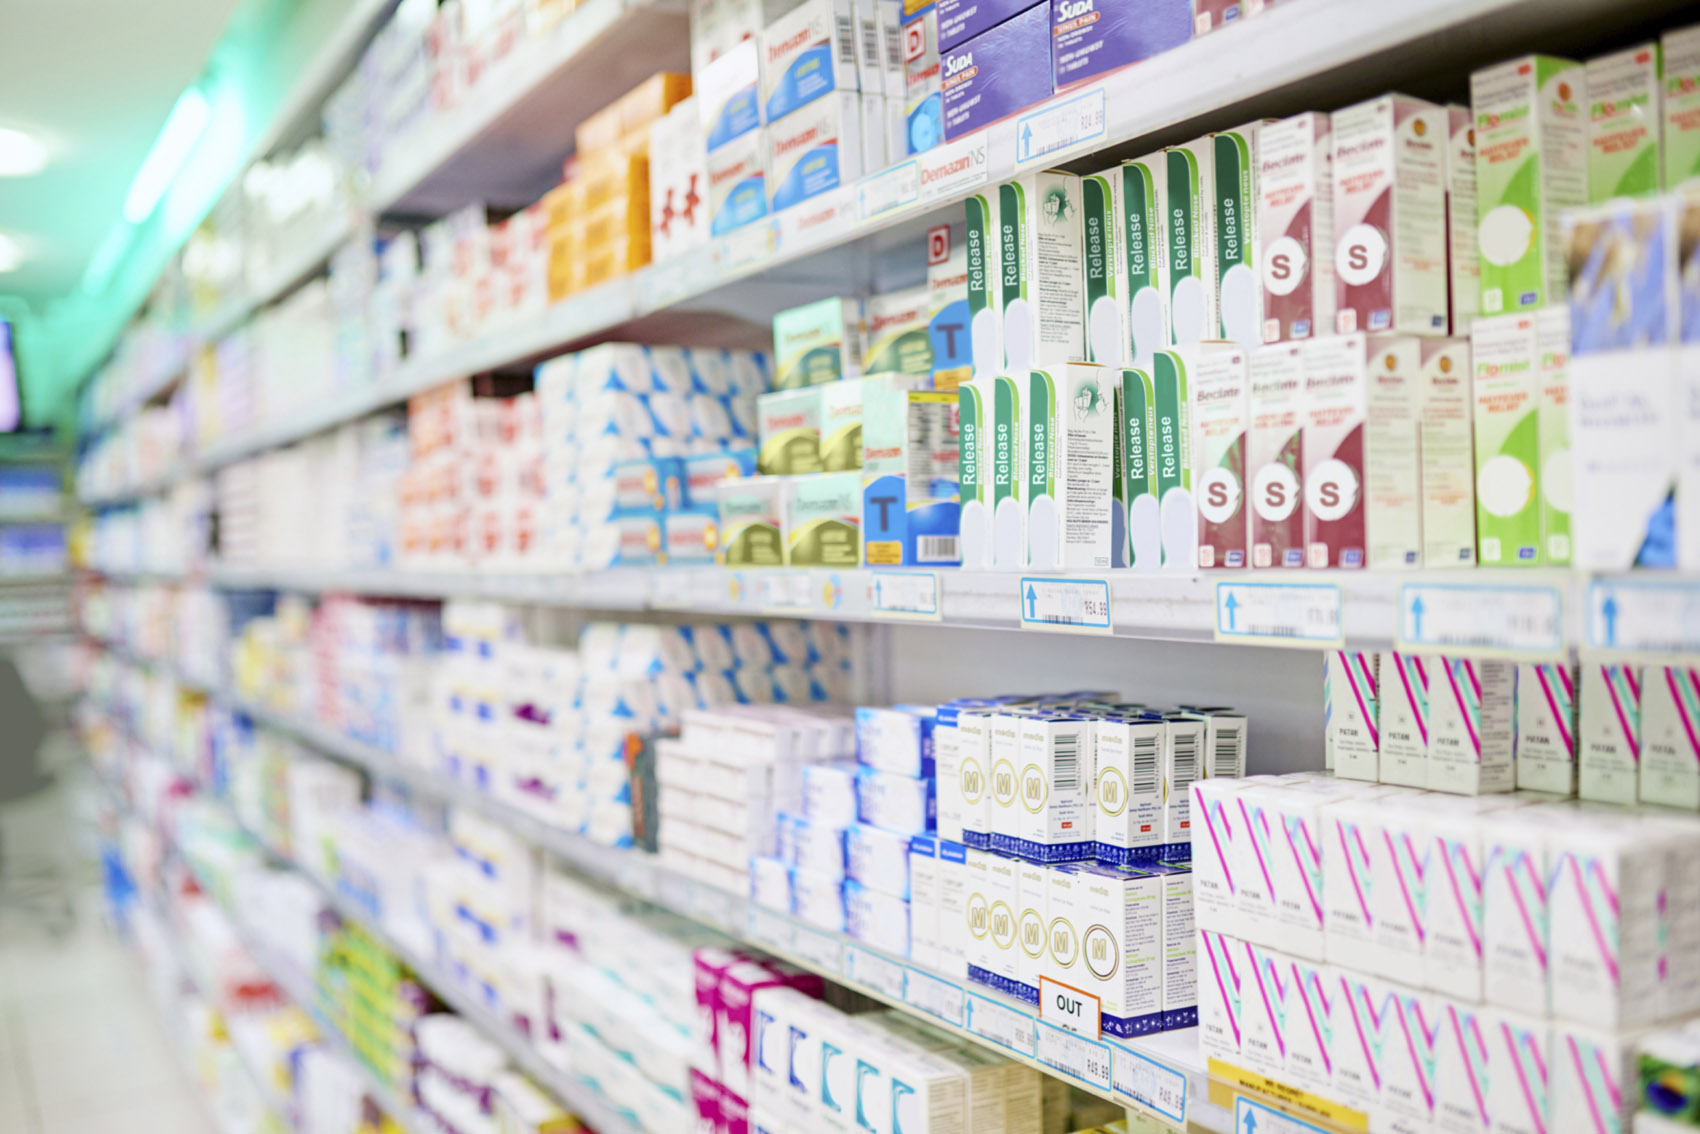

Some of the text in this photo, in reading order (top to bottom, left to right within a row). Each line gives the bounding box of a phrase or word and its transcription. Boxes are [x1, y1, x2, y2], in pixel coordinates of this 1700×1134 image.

[910, 31, 919, 52] D
[945, 52, 972, 77] SUDA
[1173, 208, 1188, 271] Release
[1223, 198, 1239, 260] Release
[933, 235, 944, 257] D
[1003, 224, 1018, 287] Release
[1088, 216, 1103, 279] Release
[1130, 213, 1145, 276] Release
[1348, 245, 1368, 270] S
[969, 229, 984, 292] Release
[1271, 254, 1290, 280] S
[936, 323, 964, 358] T
[962, 423, 976, 485] Release
[996, 423, 1010, 485] Release
[1032, 423, 1046, 485] Release
[1130, 417, 1144, 479] Release
[1161, 416, 1176, 479] Release
[1207, 481, 1228, 507] S
[1265, 481, 1286, 507] S
[1319, 481, 1340, 507] S
[870, 497, 897, 531] T
[964, 771, 978, 793] M
[997, 773, 1011, 796] M
[1026, 777, 1041, 800] M
[1103, 781, 1117, 804] M
[971, 907, 986, 930] M
[994, 914, 1008, 937] M
[1025, 923, 1039, 946] M
[1054, 931, 1068, 954] M
[1092, 938, 1106, 962] M
[1056, 994, 1082, 1017] OUT
